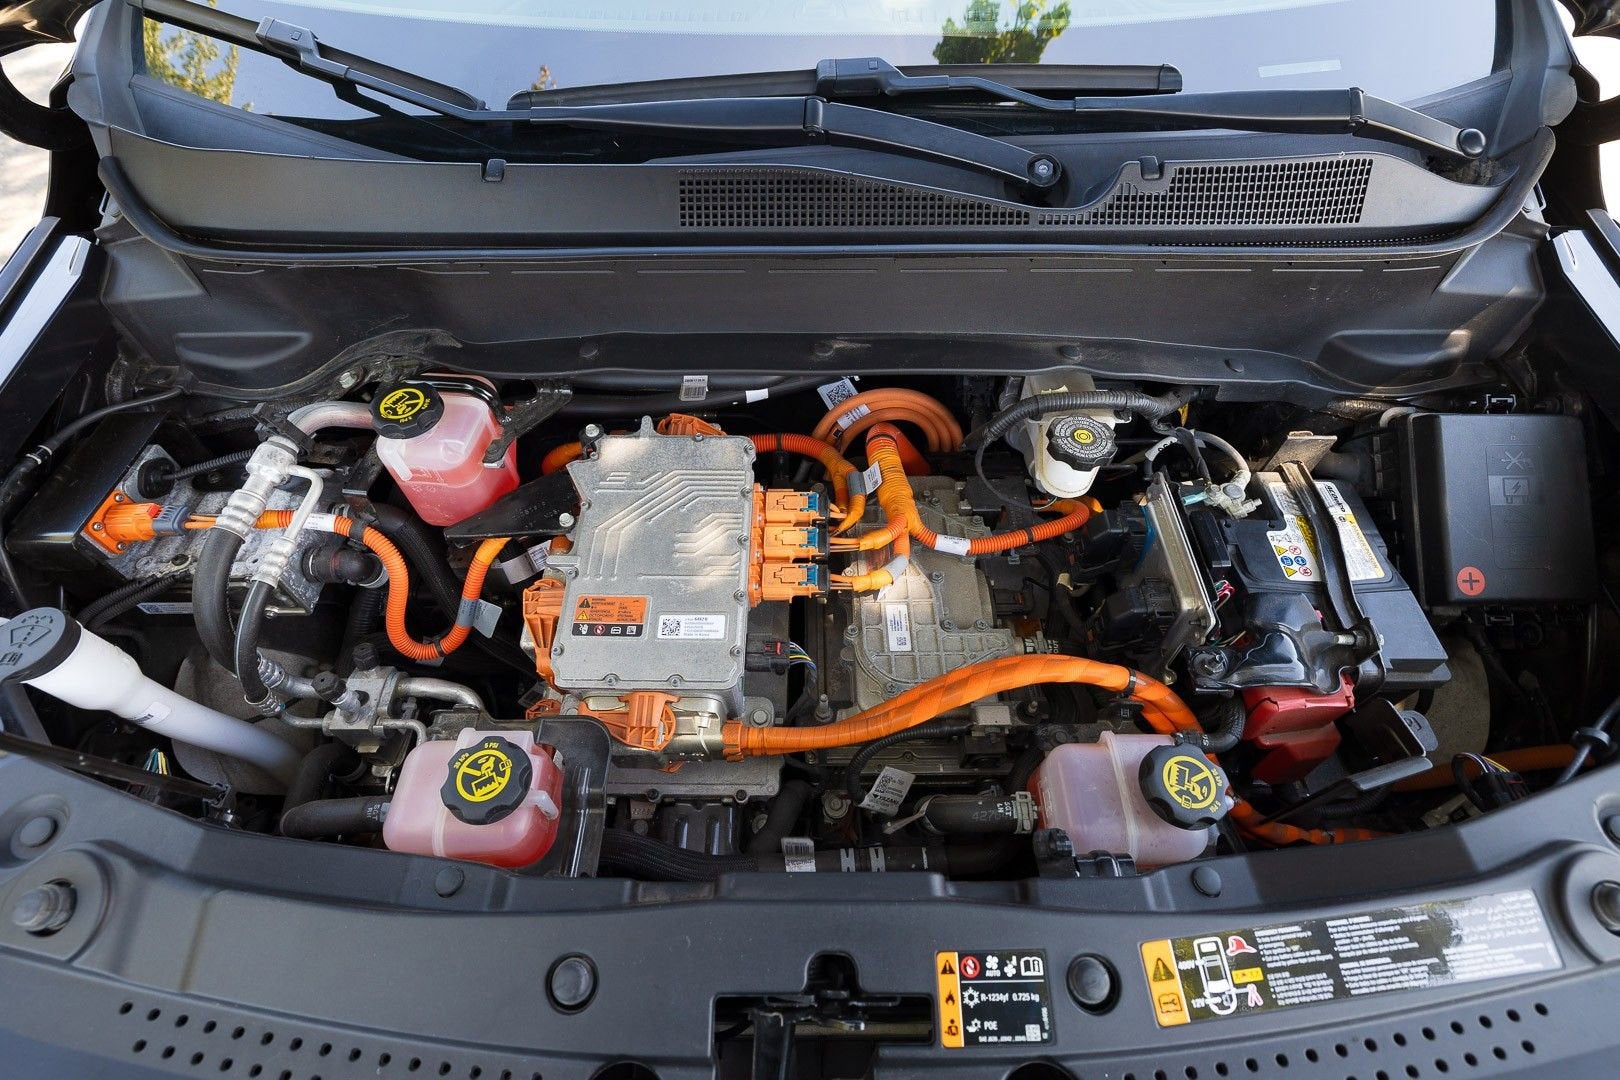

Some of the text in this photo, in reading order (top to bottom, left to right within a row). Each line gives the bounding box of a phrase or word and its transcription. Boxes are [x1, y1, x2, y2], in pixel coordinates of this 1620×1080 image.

[1004, 801, 1012, 817] SGT
[1012, 993, 1030, 1002] 0.725
[1031, 993, 1040, 1003] kg
[1191, 998, 1205, 1009] 12V
[984, 1021, 998, 1030] POE
